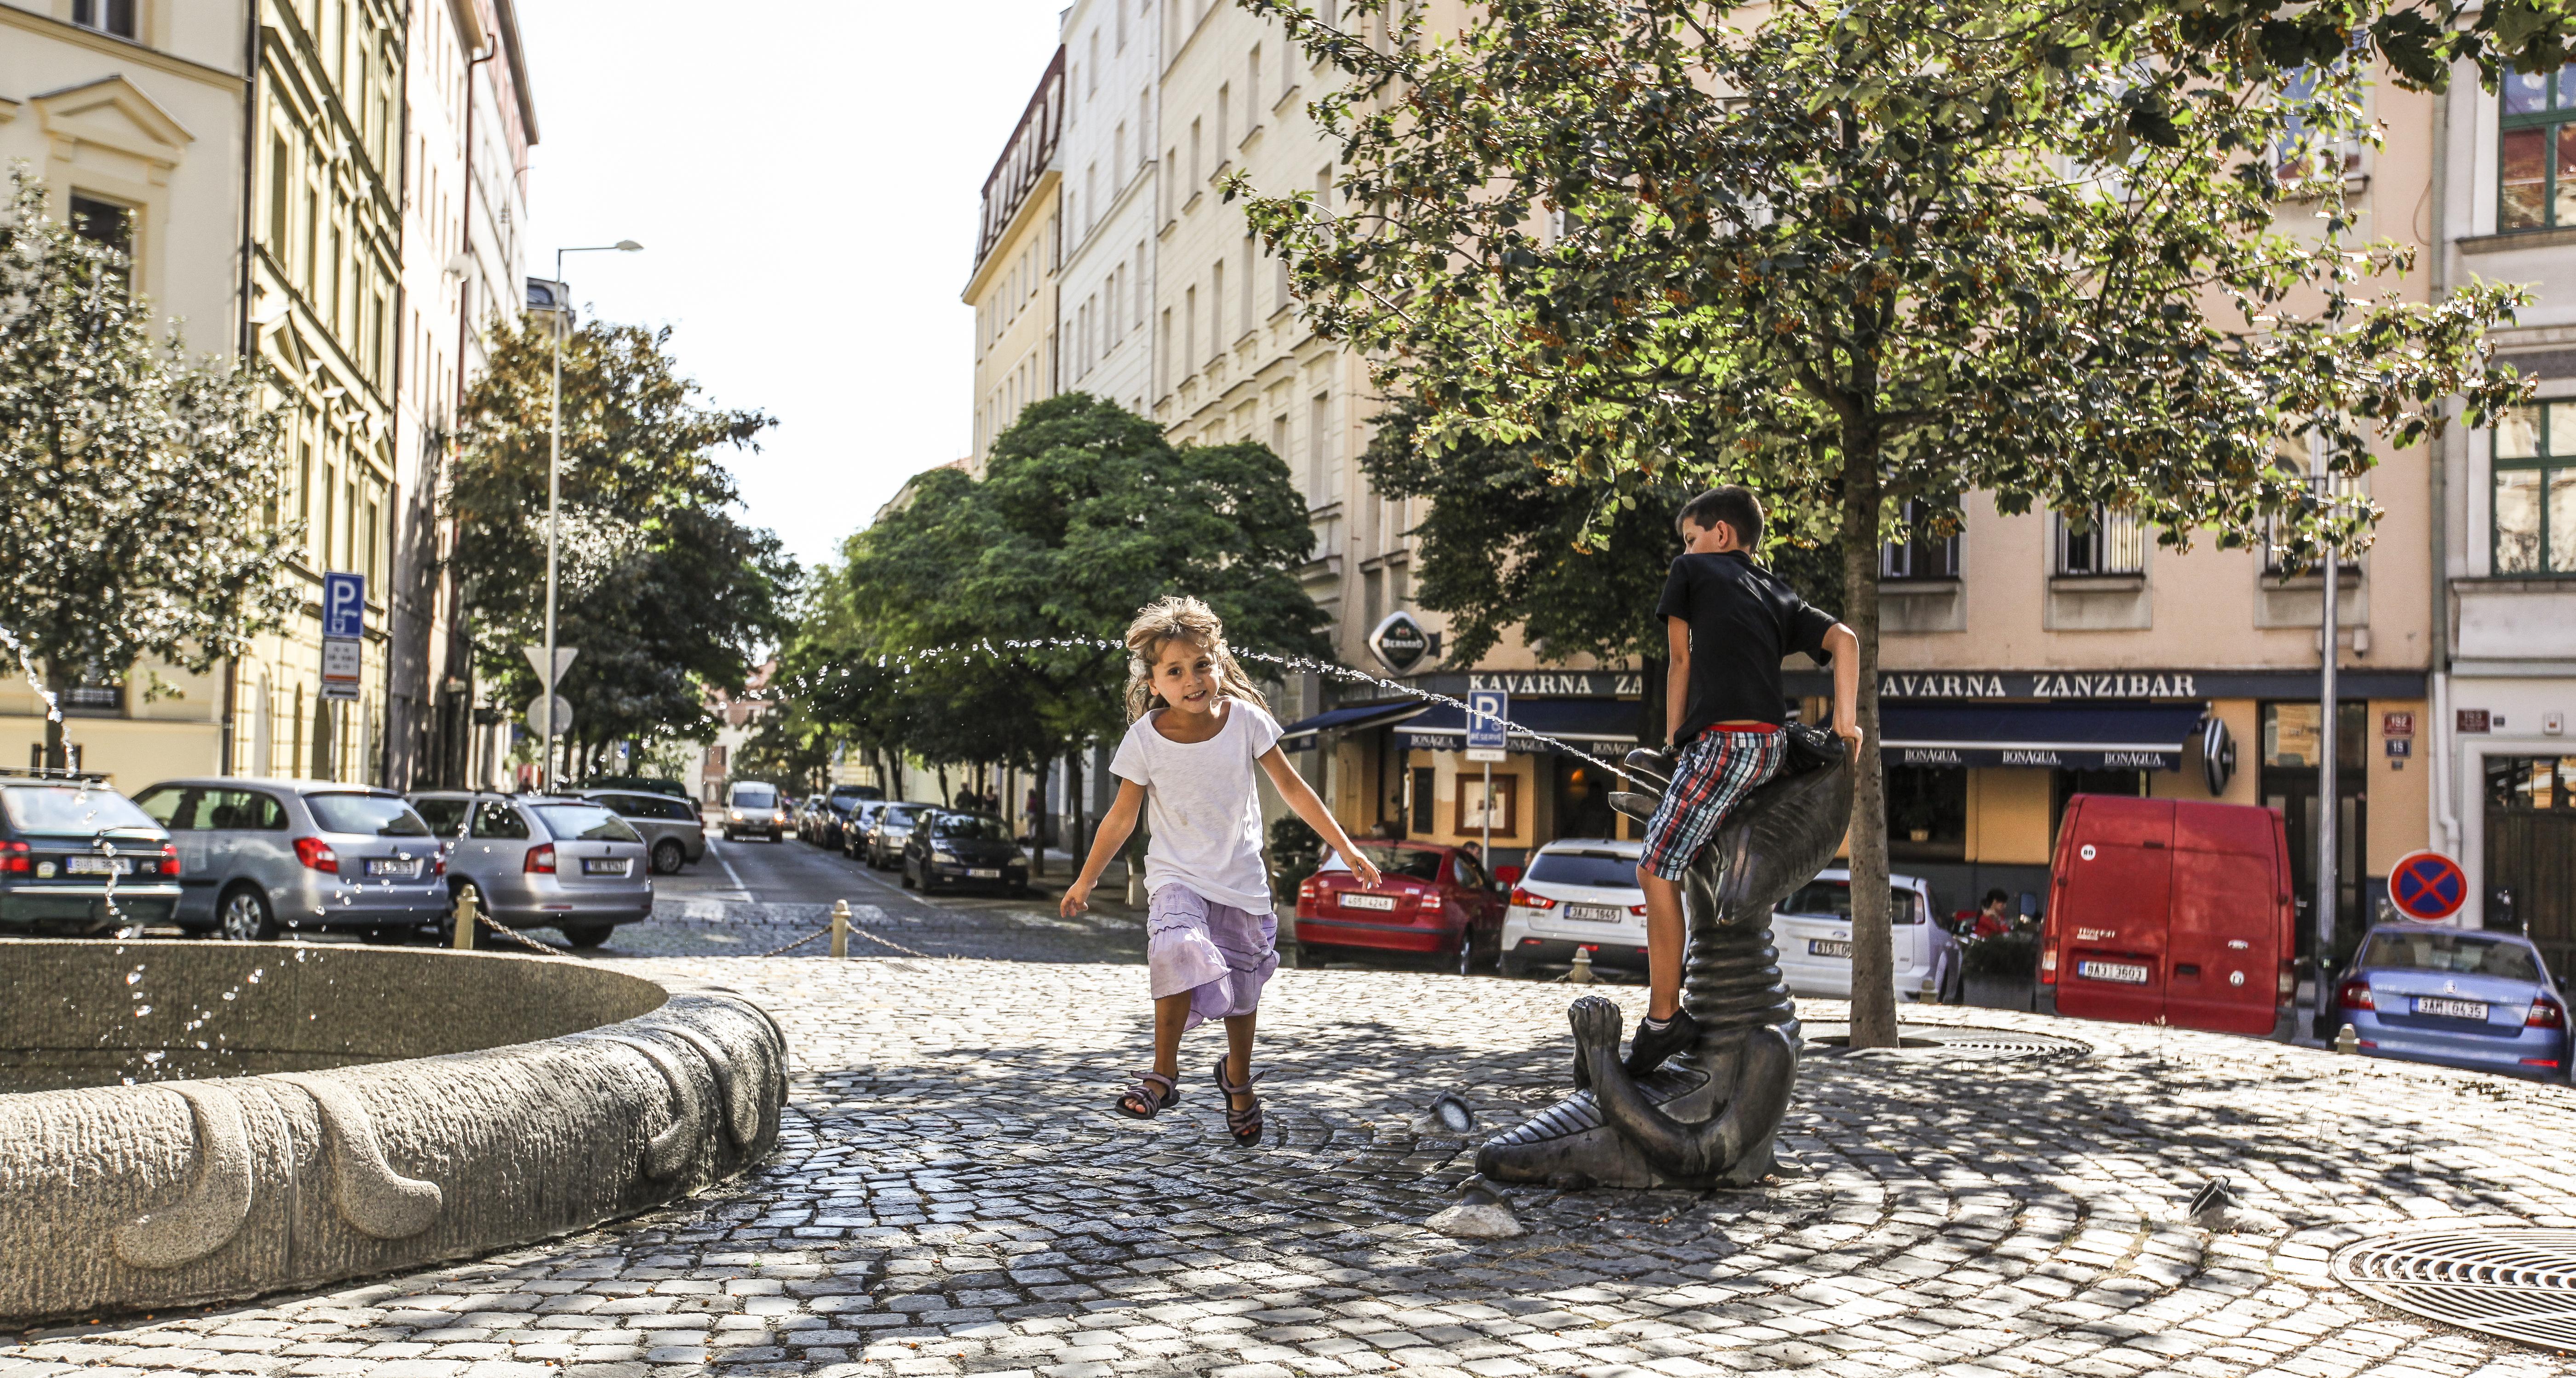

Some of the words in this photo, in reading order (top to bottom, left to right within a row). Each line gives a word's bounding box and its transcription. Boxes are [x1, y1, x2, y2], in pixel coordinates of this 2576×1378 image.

[333, 579, 356, 617] P
[1469, 675, 1592, 694] KAVÁRNA
[1881, 675, 2006, 697] AVÁRNA
[2033, 674, 2196, 697] ZANZIBAR
[1475, 696, 1498, 730] P
[1905, 748, 1957, 763] BONAQUA
[2002, 749, 2057, 765] BONAQUA
[2104, 750, 2161, 766] BONAQUA
